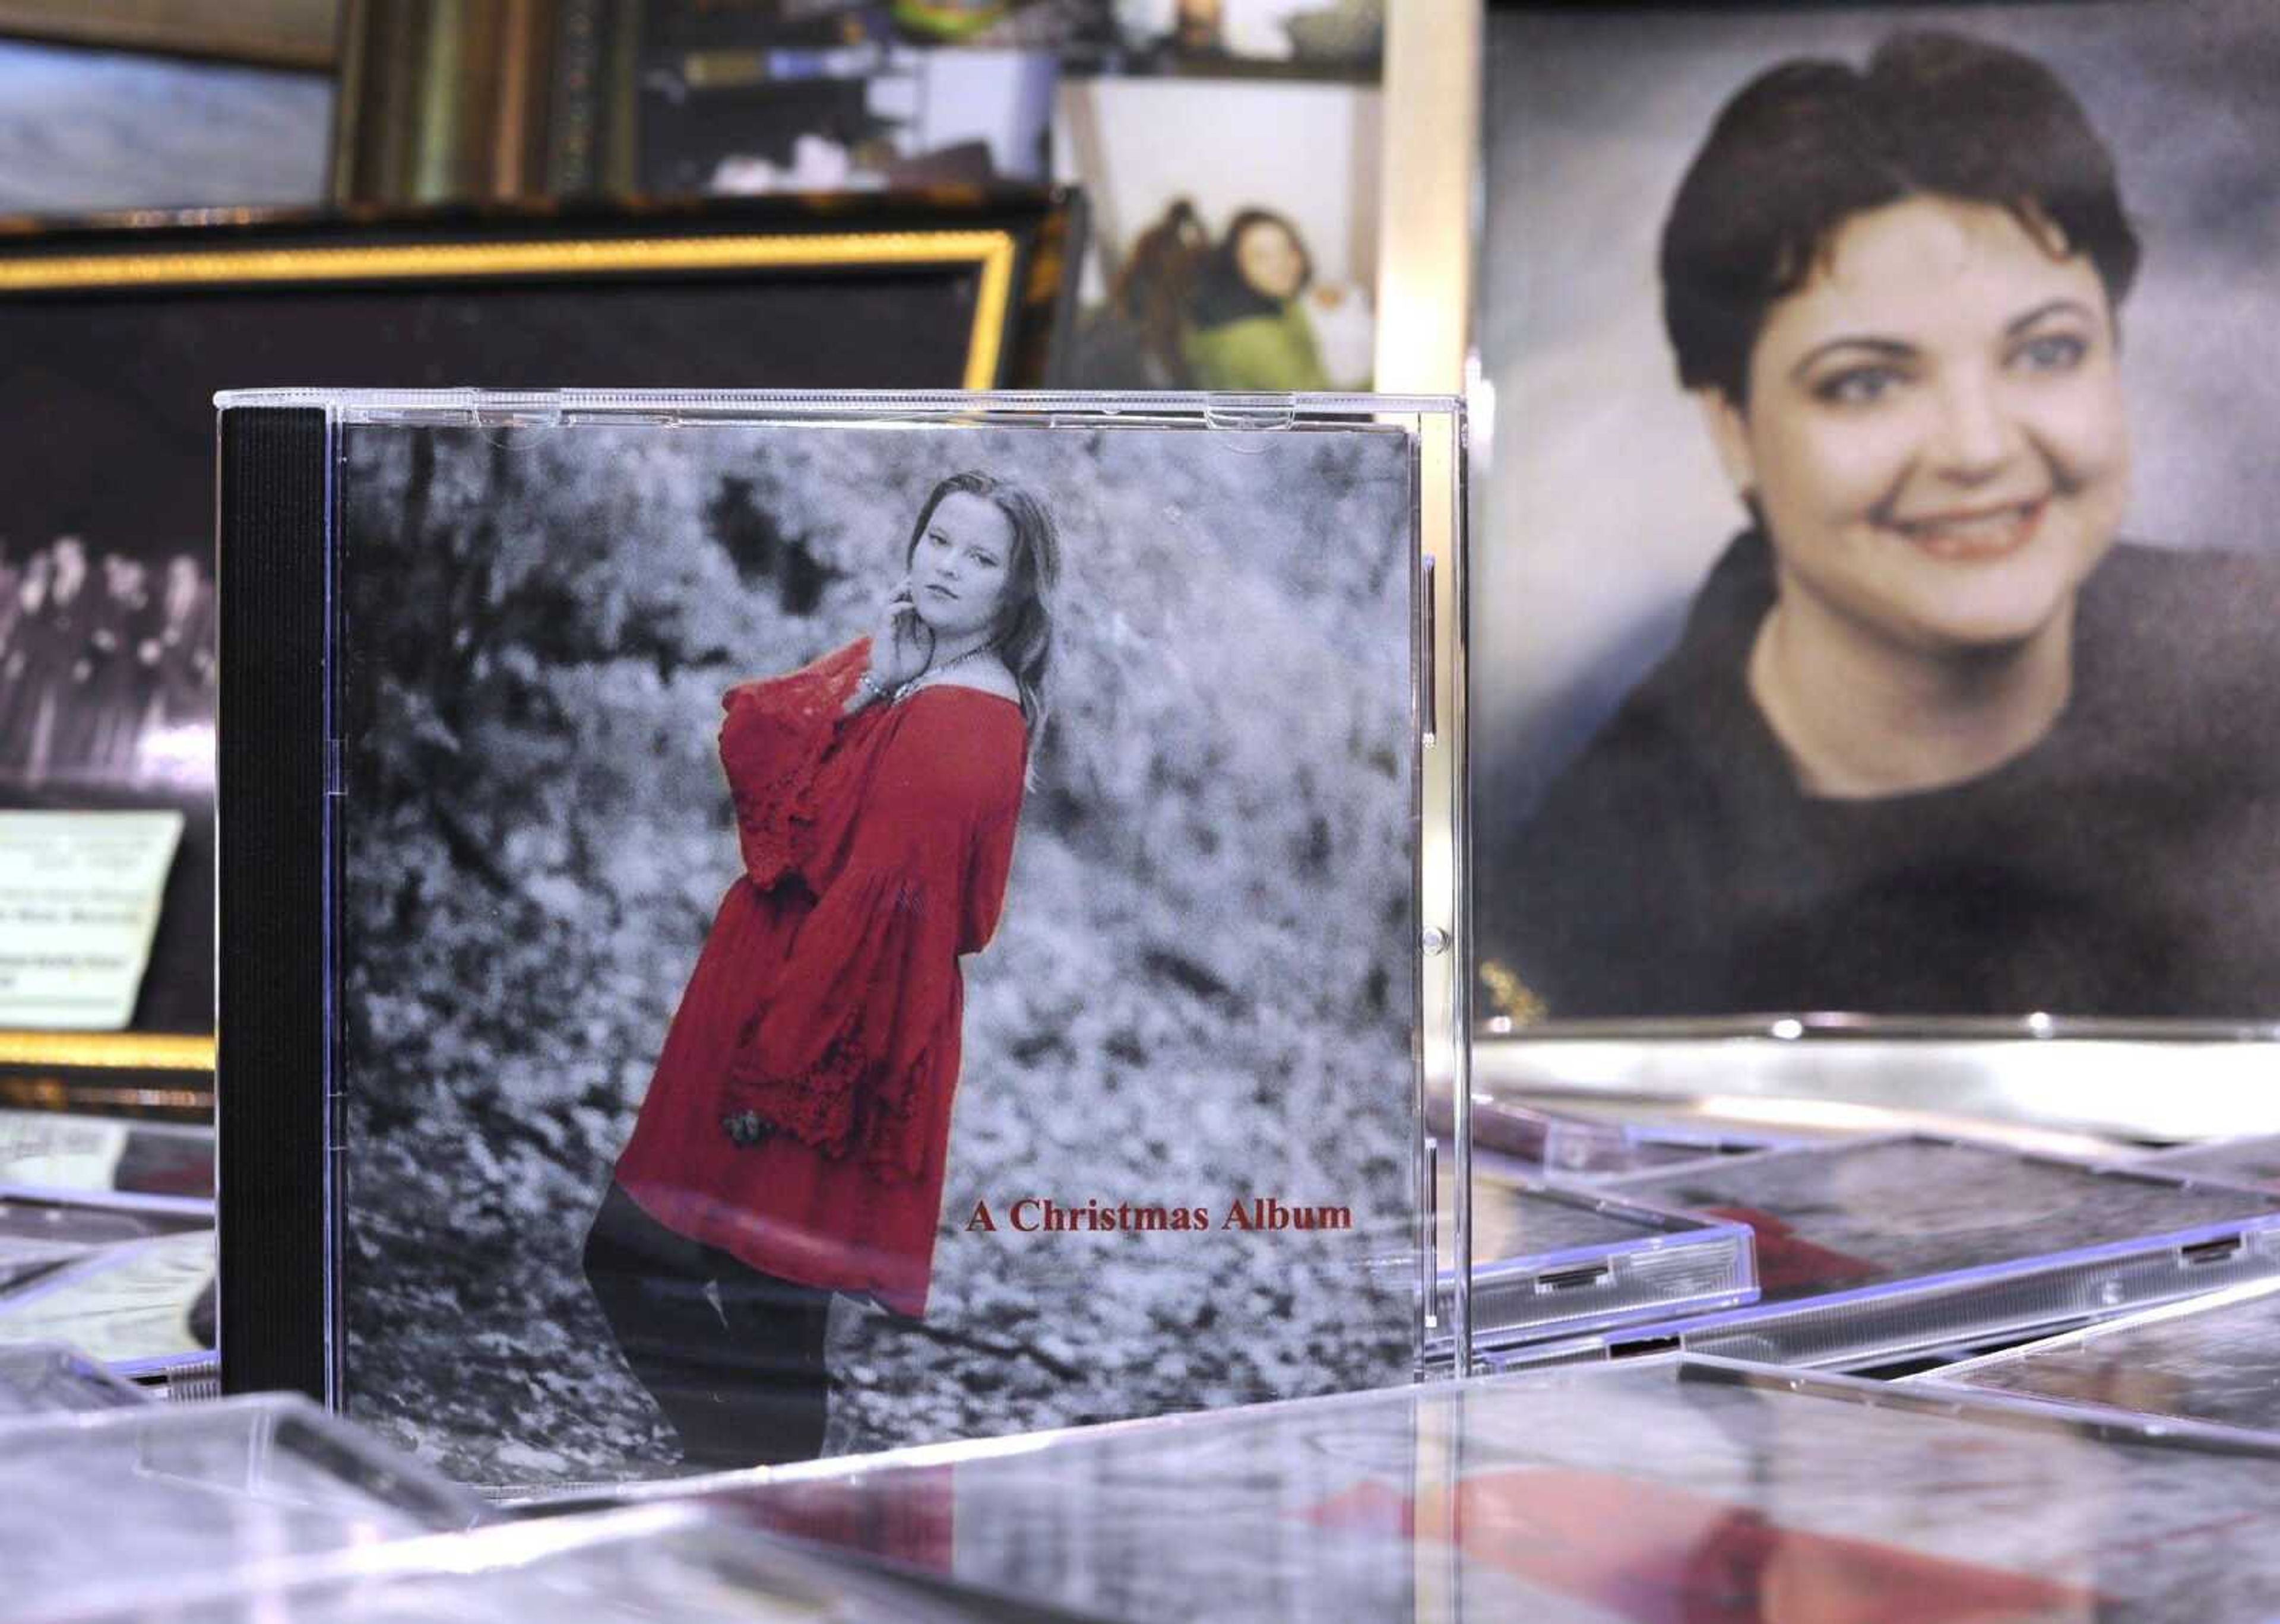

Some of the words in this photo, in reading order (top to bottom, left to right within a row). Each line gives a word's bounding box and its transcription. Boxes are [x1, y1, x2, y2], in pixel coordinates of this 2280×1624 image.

[965, 1200, 996, 1231] A
[1010, 1198, 1209, 1232] Christmas
[1221, 1198, 1351, 1230] Album
